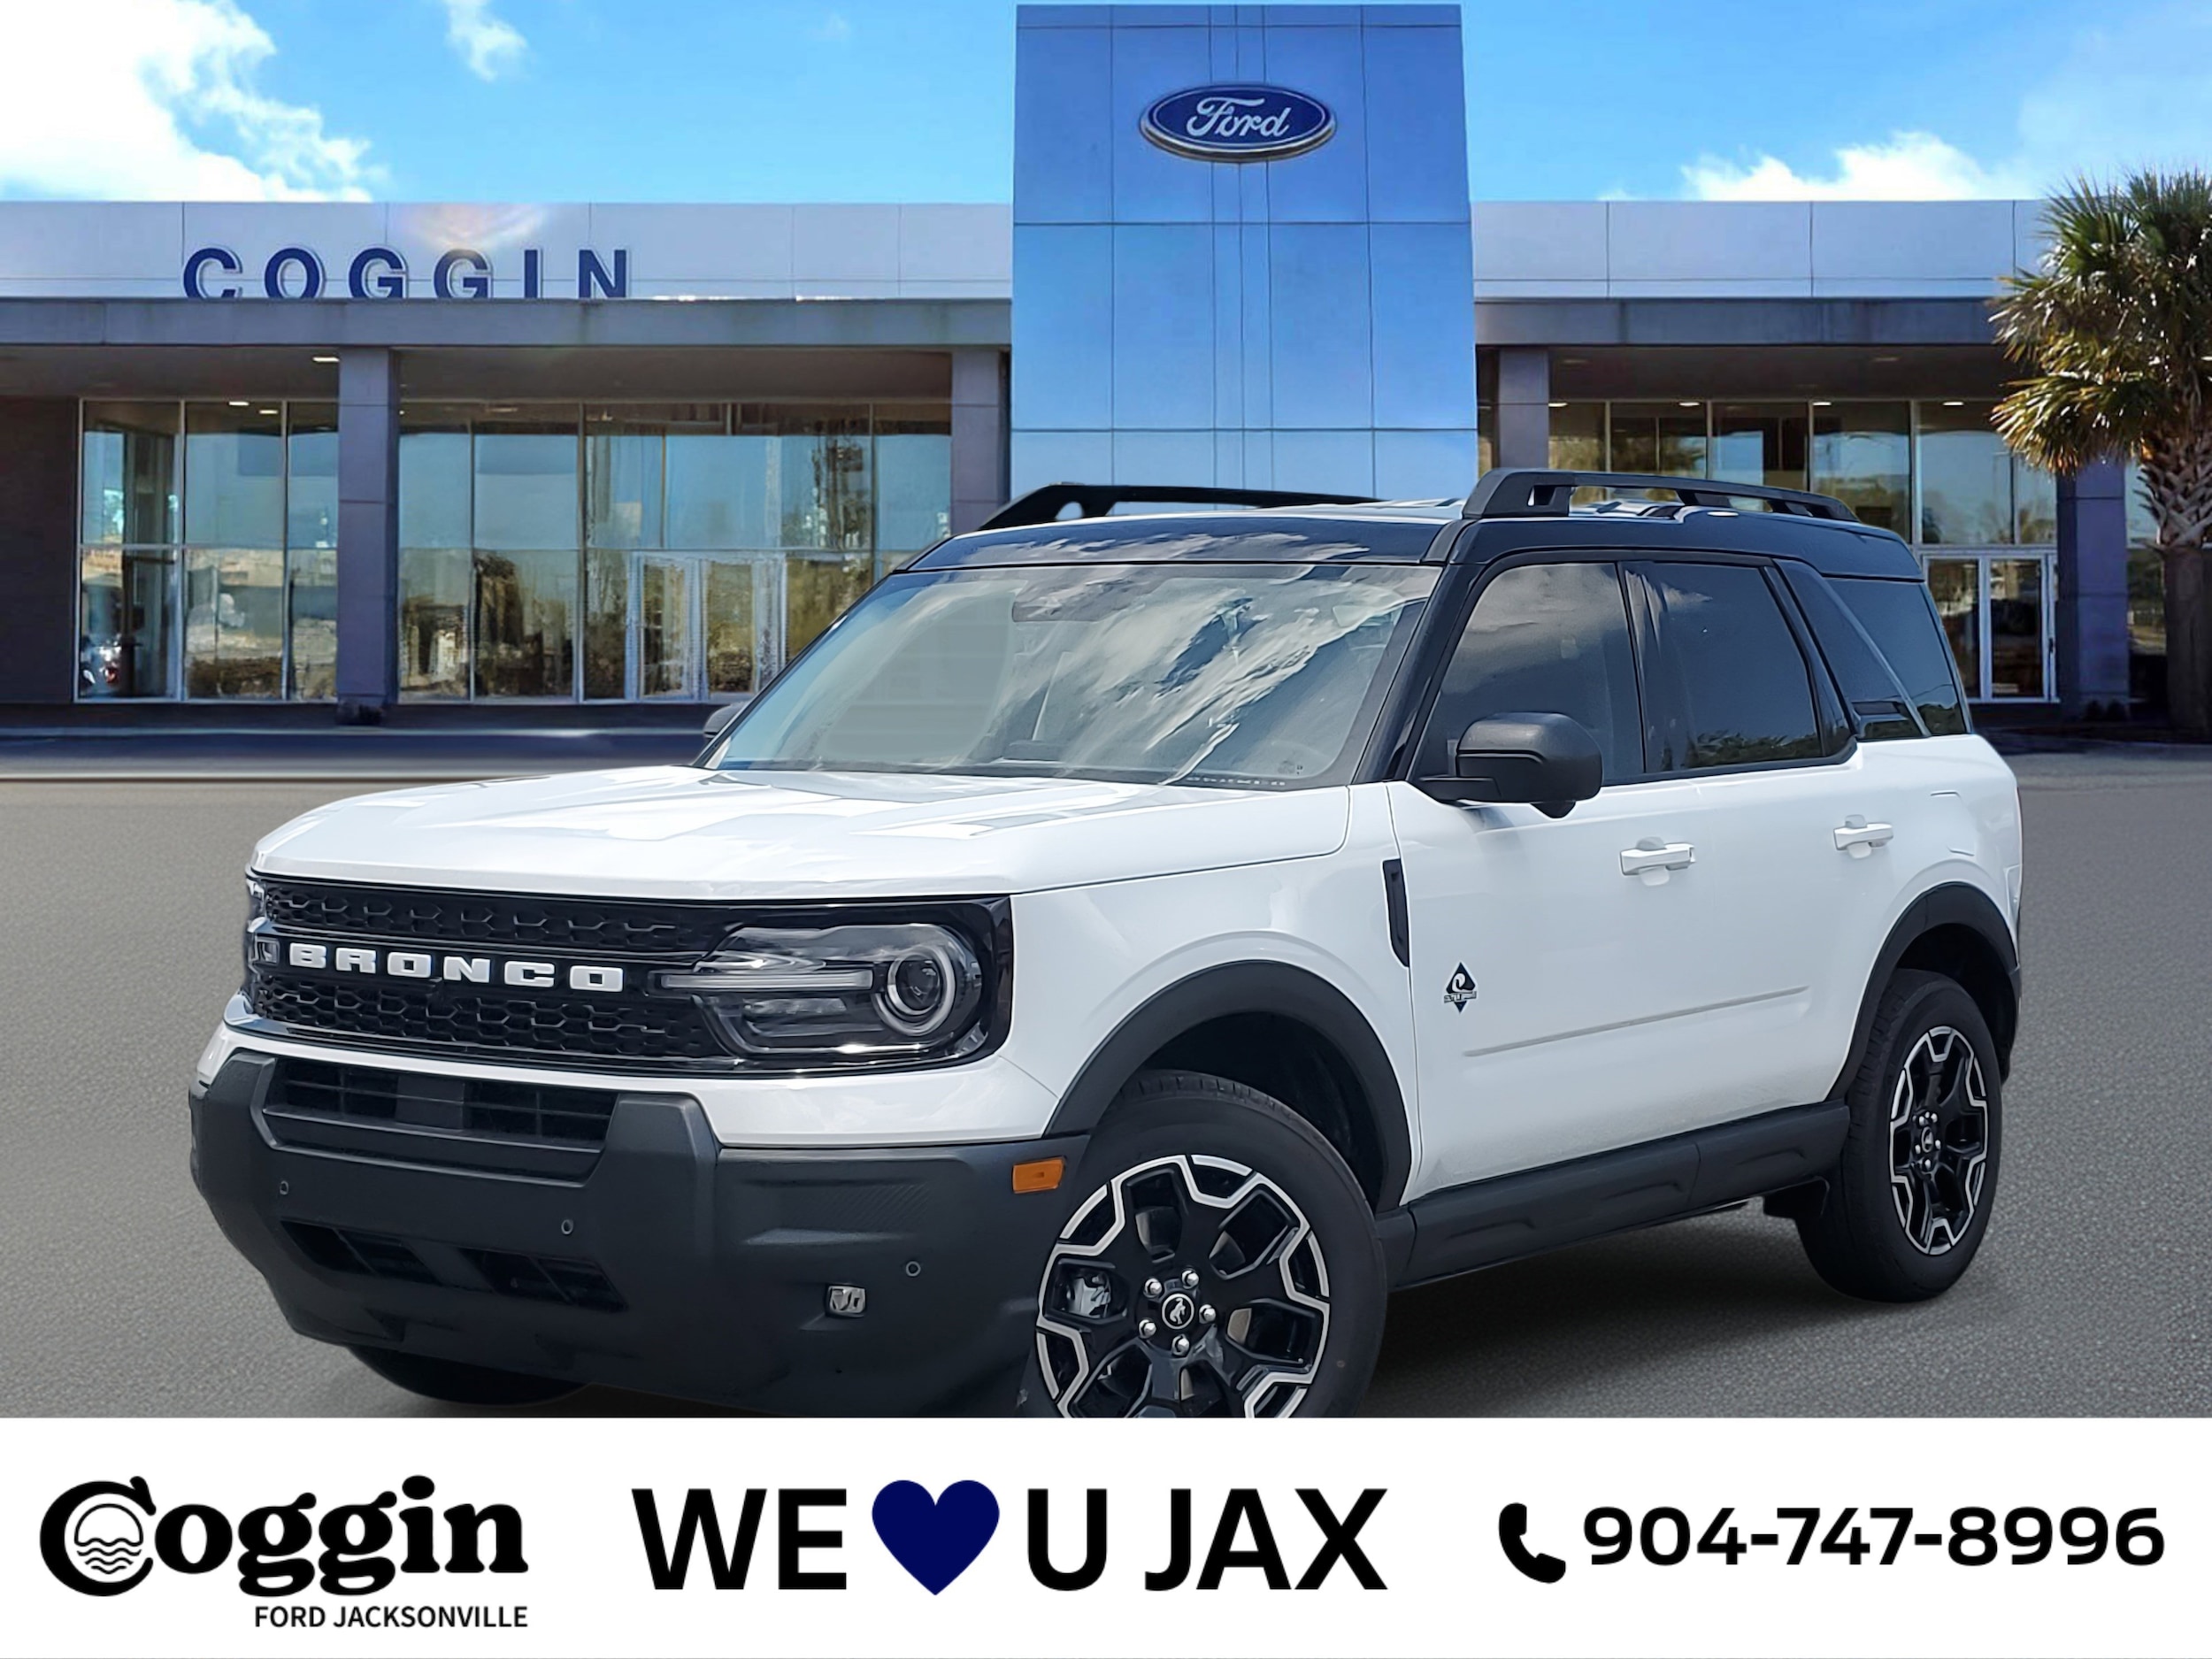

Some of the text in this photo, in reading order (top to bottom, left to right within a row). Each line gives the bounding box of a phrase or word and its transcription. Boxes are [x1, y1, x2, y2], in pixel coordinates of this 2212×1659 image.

[1186, 96, 1292, 137] Ford
[182, 247, 630, 299] COGGIN
[288, 942, 624, 993] BRONCO
